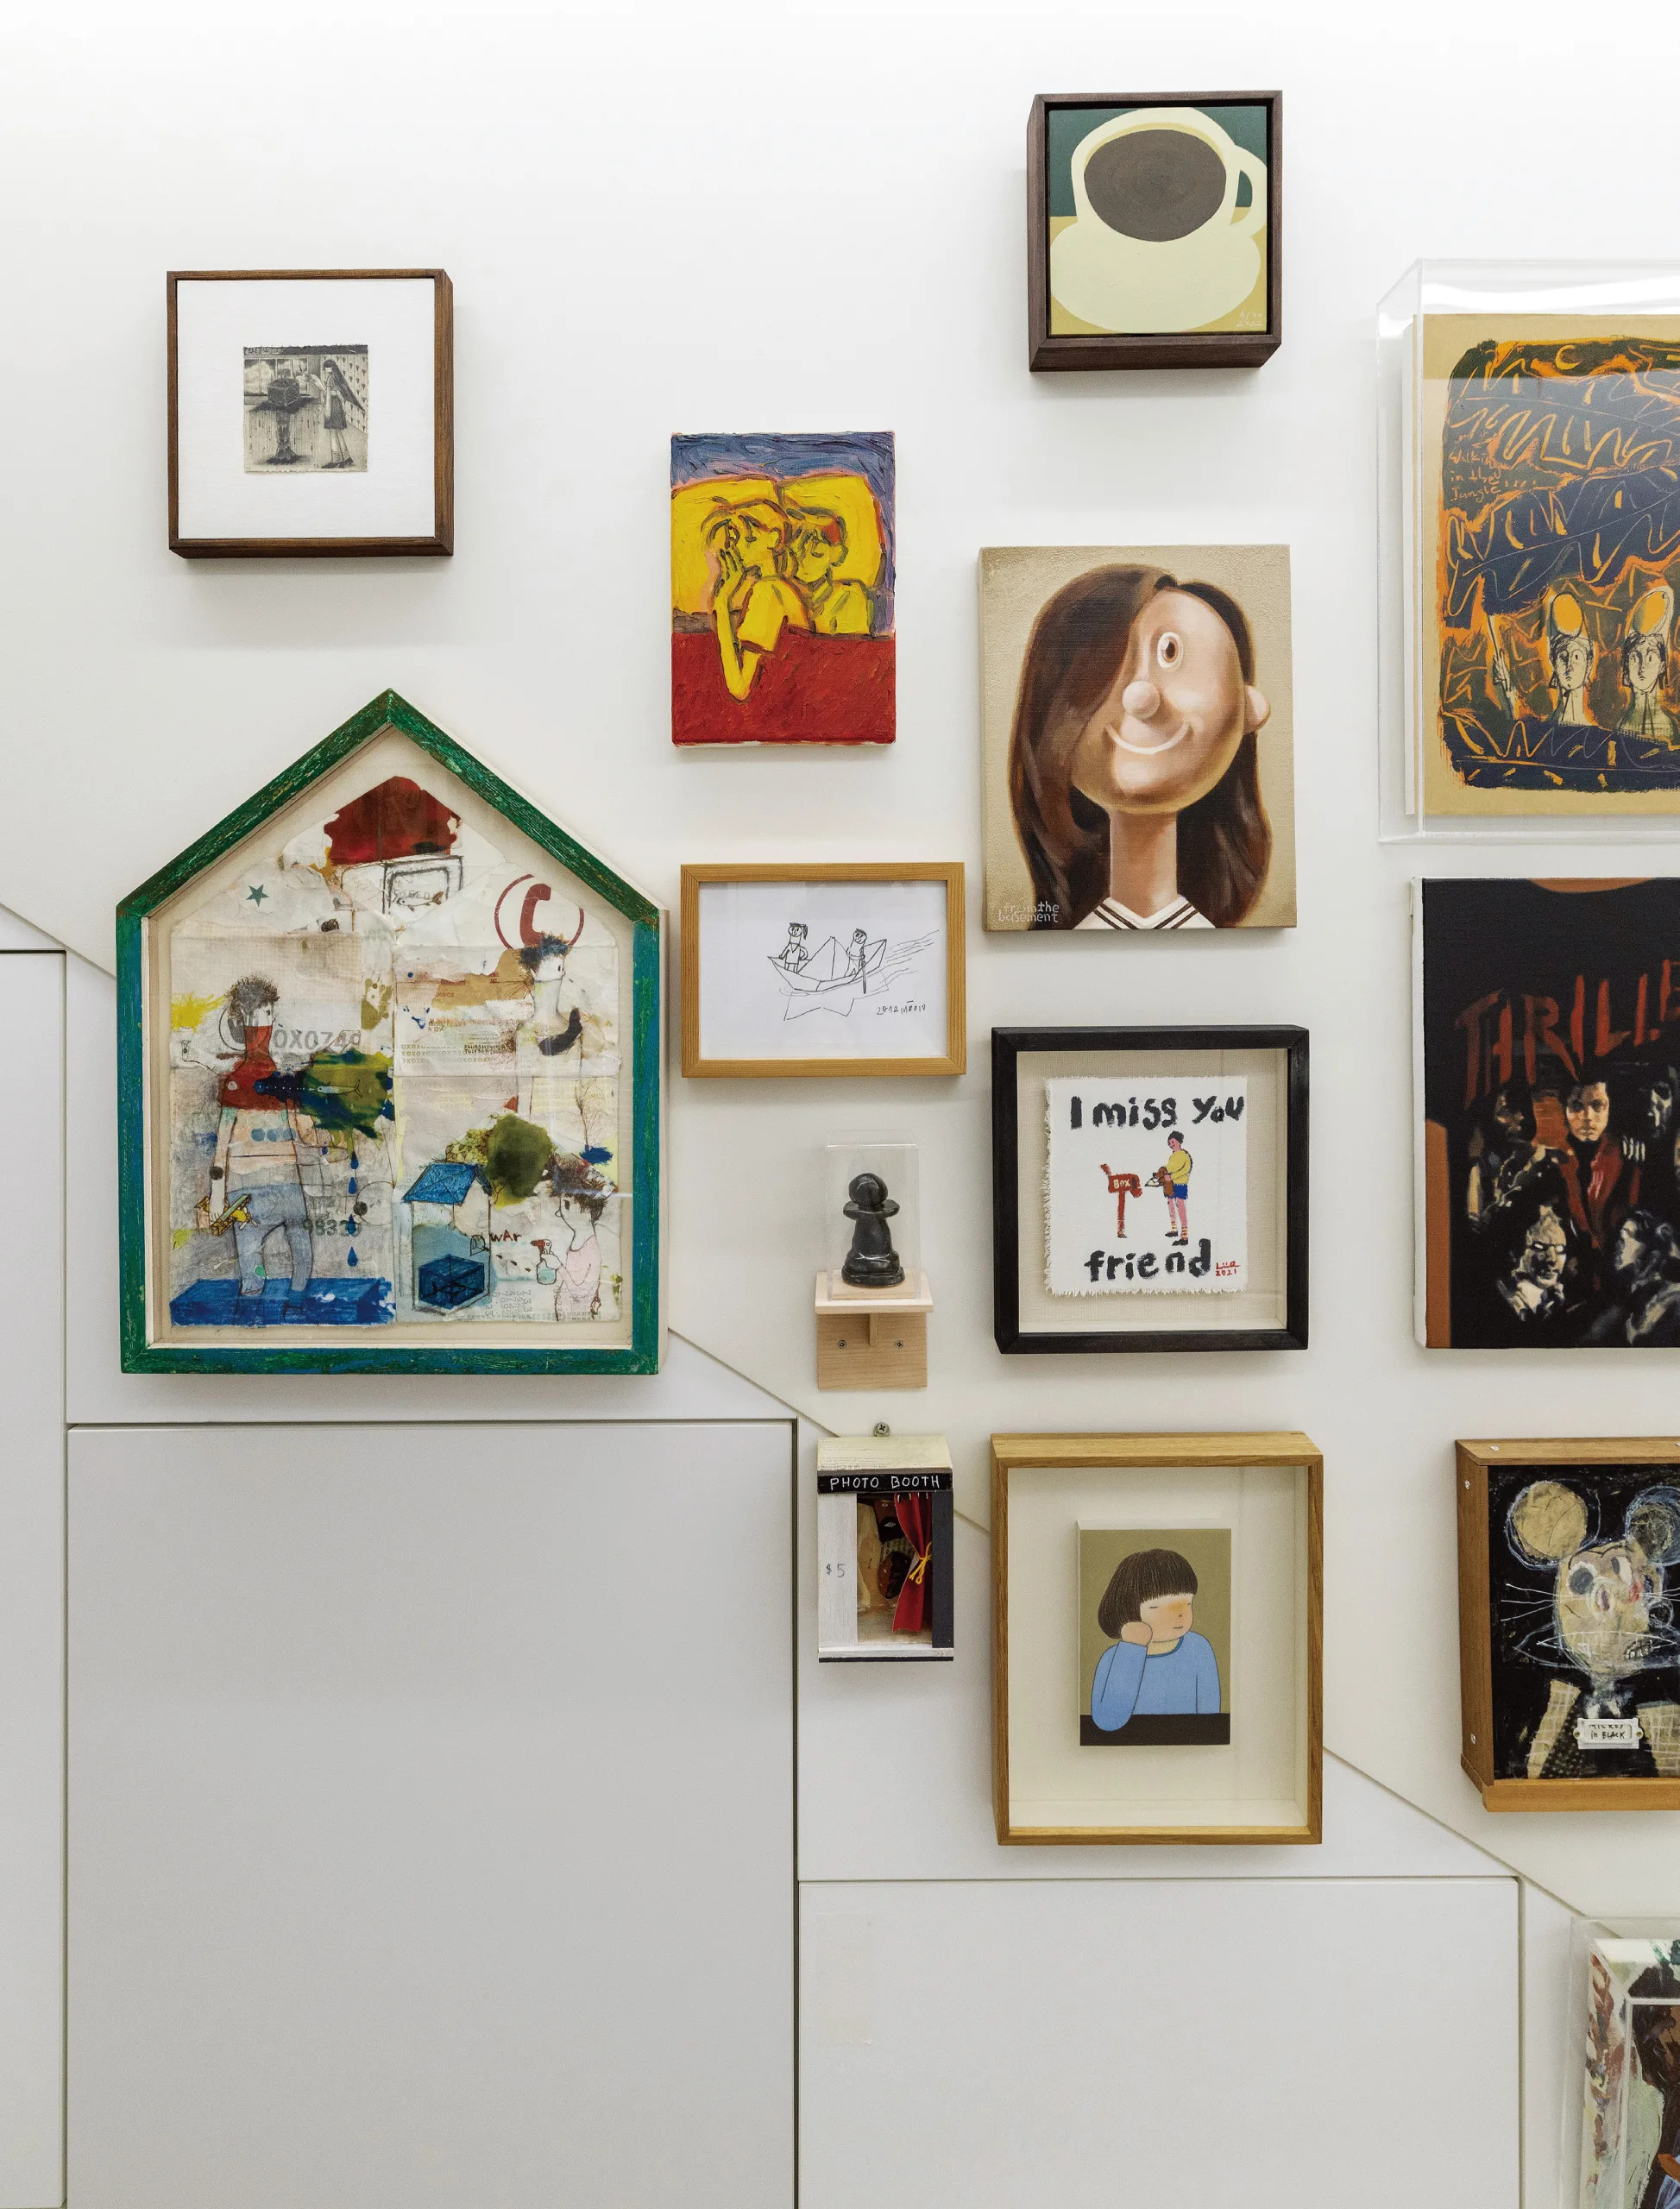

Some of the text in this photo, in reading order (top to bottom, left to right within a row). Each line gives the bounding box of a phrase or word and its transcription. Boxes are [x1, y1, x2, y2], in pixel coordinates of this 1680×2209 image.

[1037, 901, 1060, 914] the
[998, 909, 1059, 923] basement
[1070, 1096, 1082, 1130] I
[1092, 1097, 1178, 1130] miss
[1085, 1237, 1211, 1283] friend
[830, 1476, 940, 1490] PHOTO BOOTH
